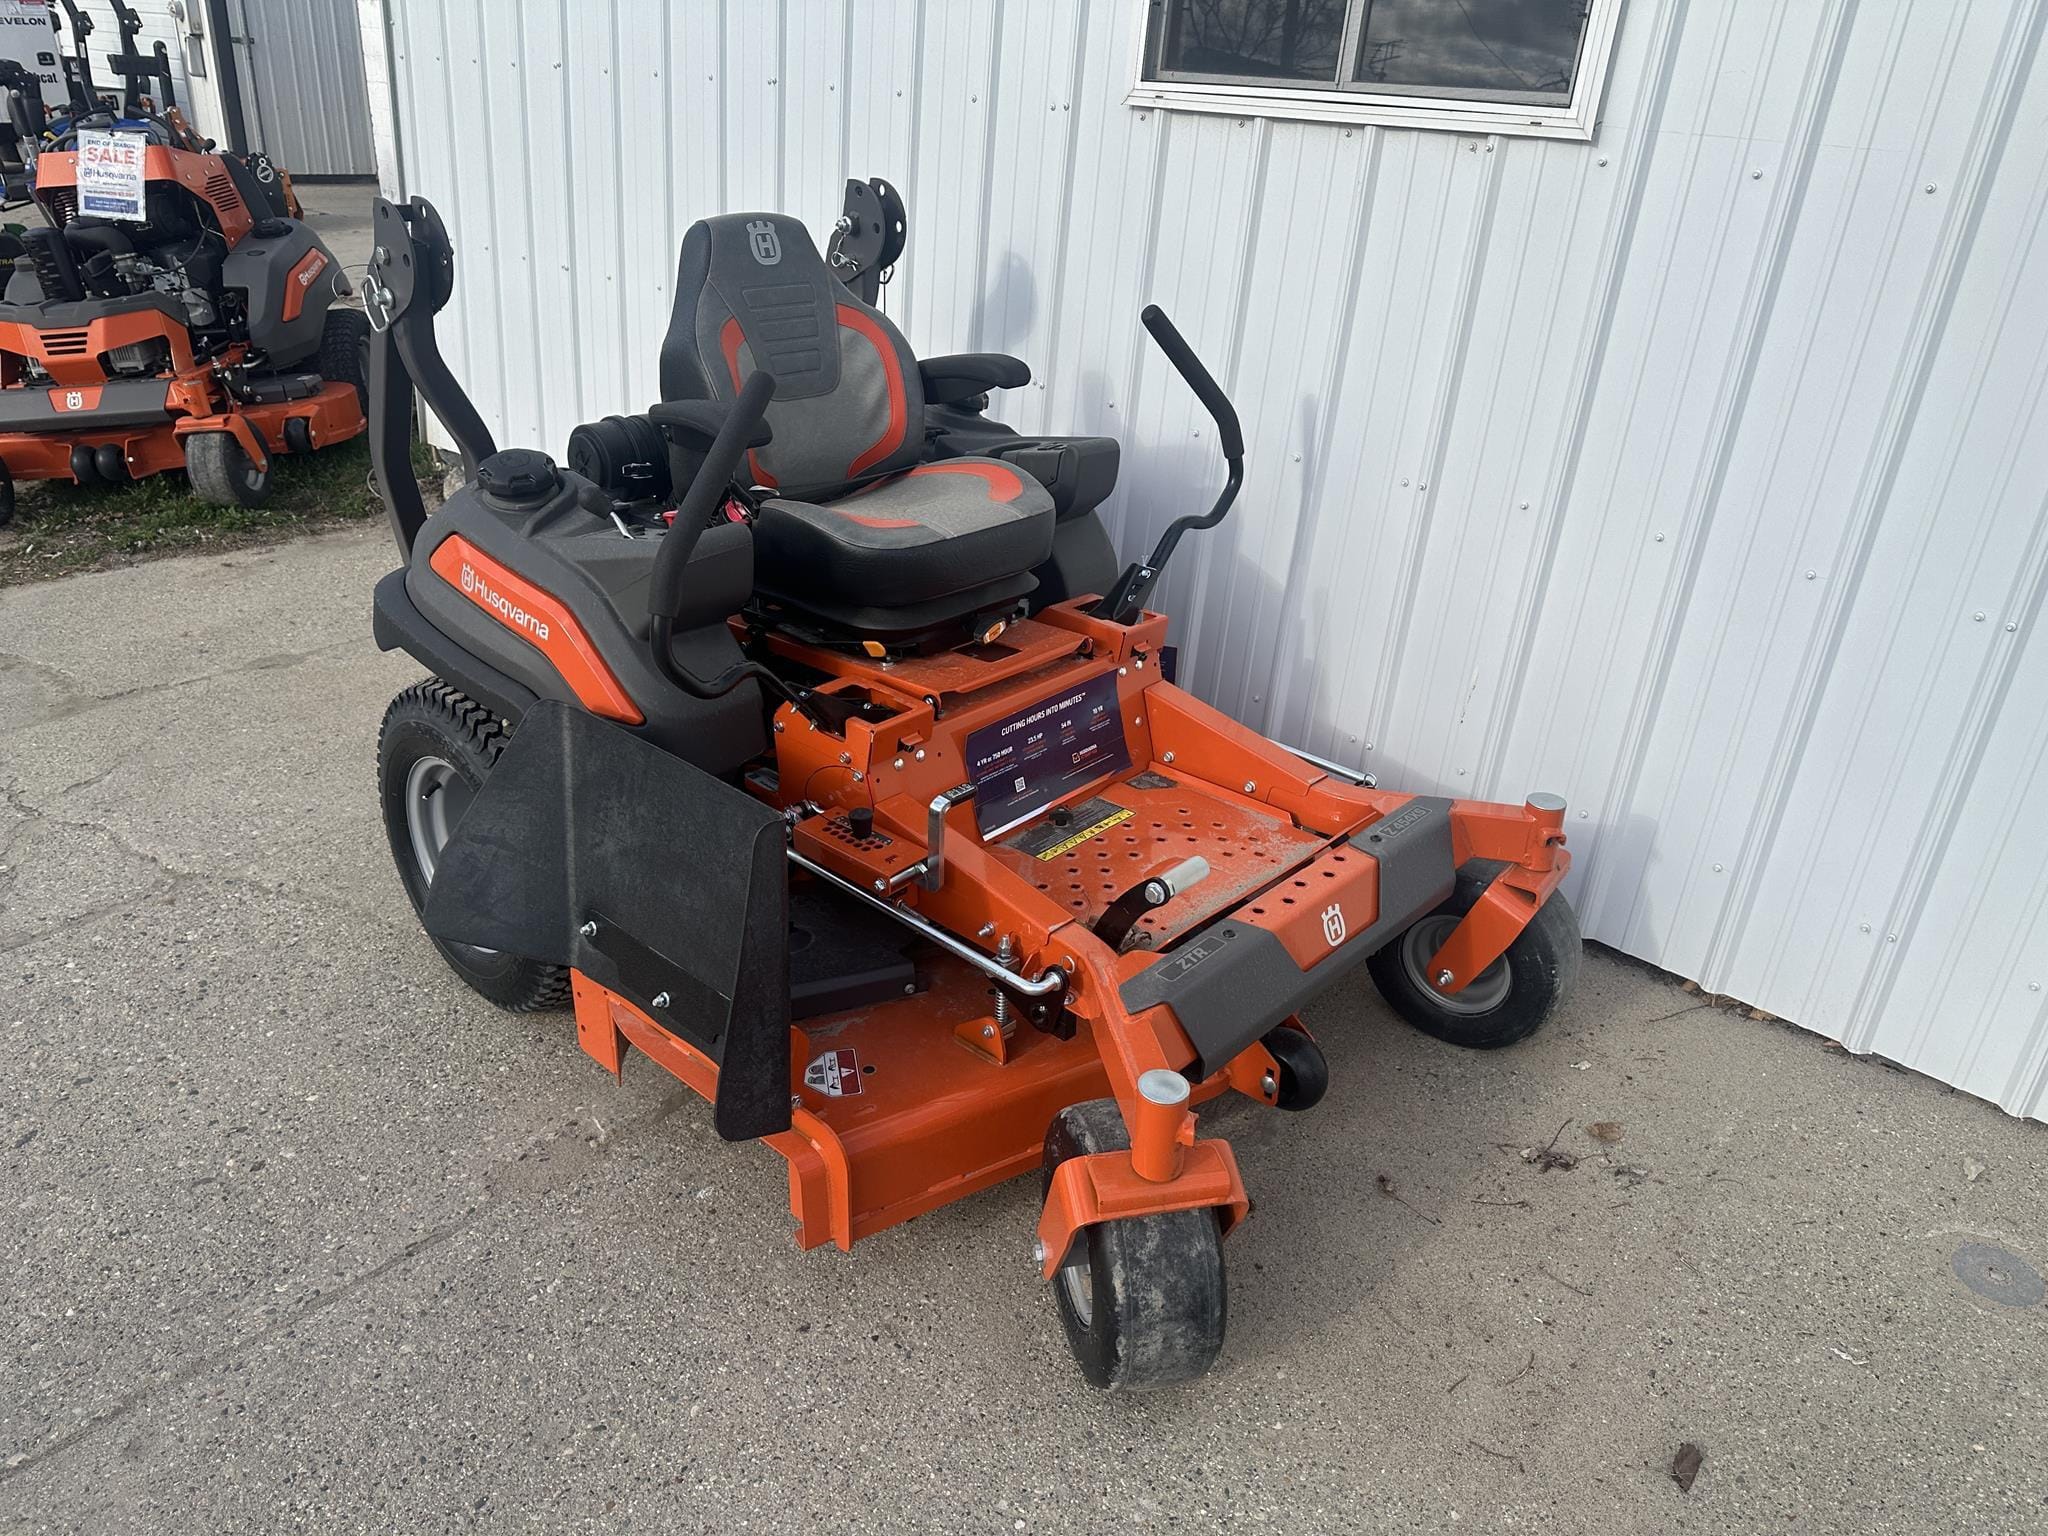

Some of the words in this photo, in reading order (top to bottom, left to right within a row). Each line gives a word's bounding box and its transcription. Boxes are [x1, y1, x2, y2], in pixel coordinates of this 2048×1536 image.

[37, 72, 58, 83] cat
[87, 146, 135, 165] SALE
[93, 169, 137, 180] Husqvarna
[474, 575, 549, 641] Husqvarna
[1001, 719, 1026, 736] CUTTING
[1026, 710, 1046, 726] HOURS
[1046, 704, 1059, 717] INTO
[1000, 746, 1013, 757] HOUR
